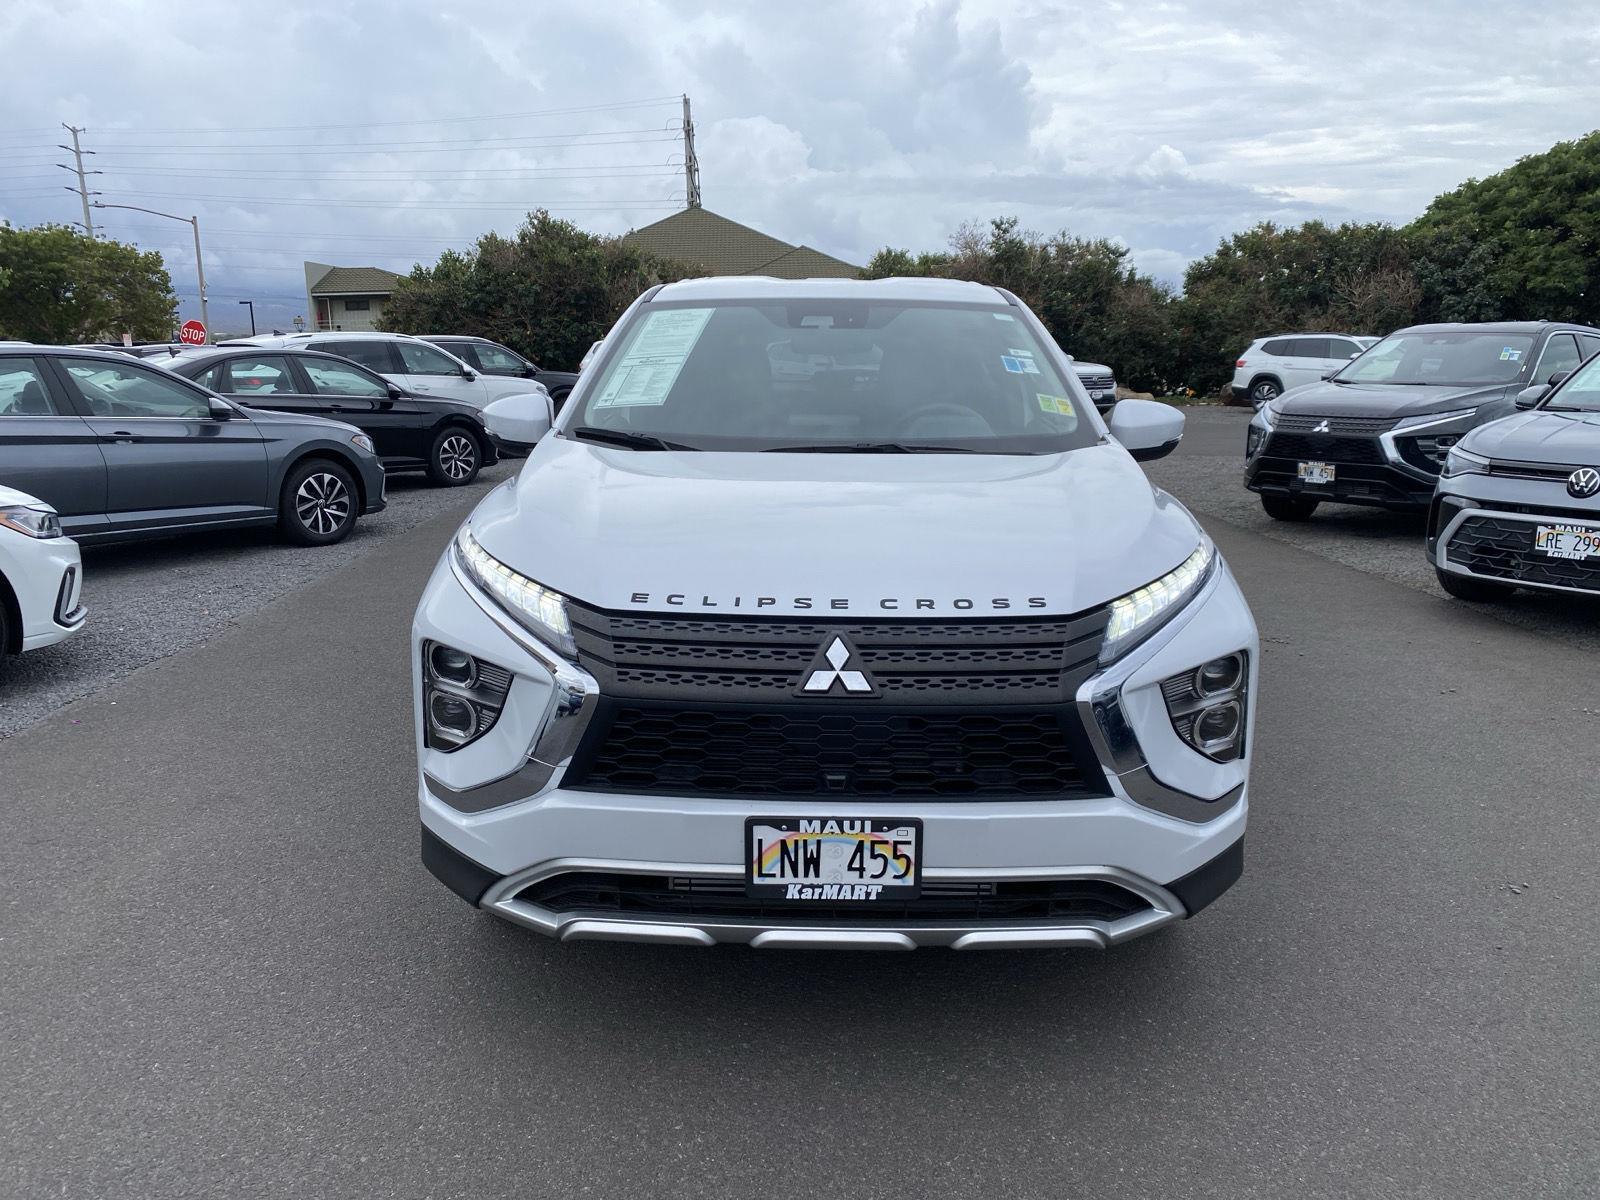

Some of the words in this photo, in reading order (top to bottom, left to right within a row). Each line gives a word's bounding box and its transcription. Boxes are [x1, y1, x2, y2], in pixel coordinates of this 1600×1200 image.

[182, 328, 205, 341] STOP
[1555, 525, 1586, 534] MAUI
[1537, 531, 1564, 550] LRE
[1573, 535, 1600, 552] 299
[630, 592, 849, 610] ECLIPSE
[880, 597, 1047, 610] CROSS
[799, 819, 872, 834] MAUI
[757, 838, 822, 879] LNW
[847, 839, 912, 879] 455
[786, 883, 883, 900] KarMART
